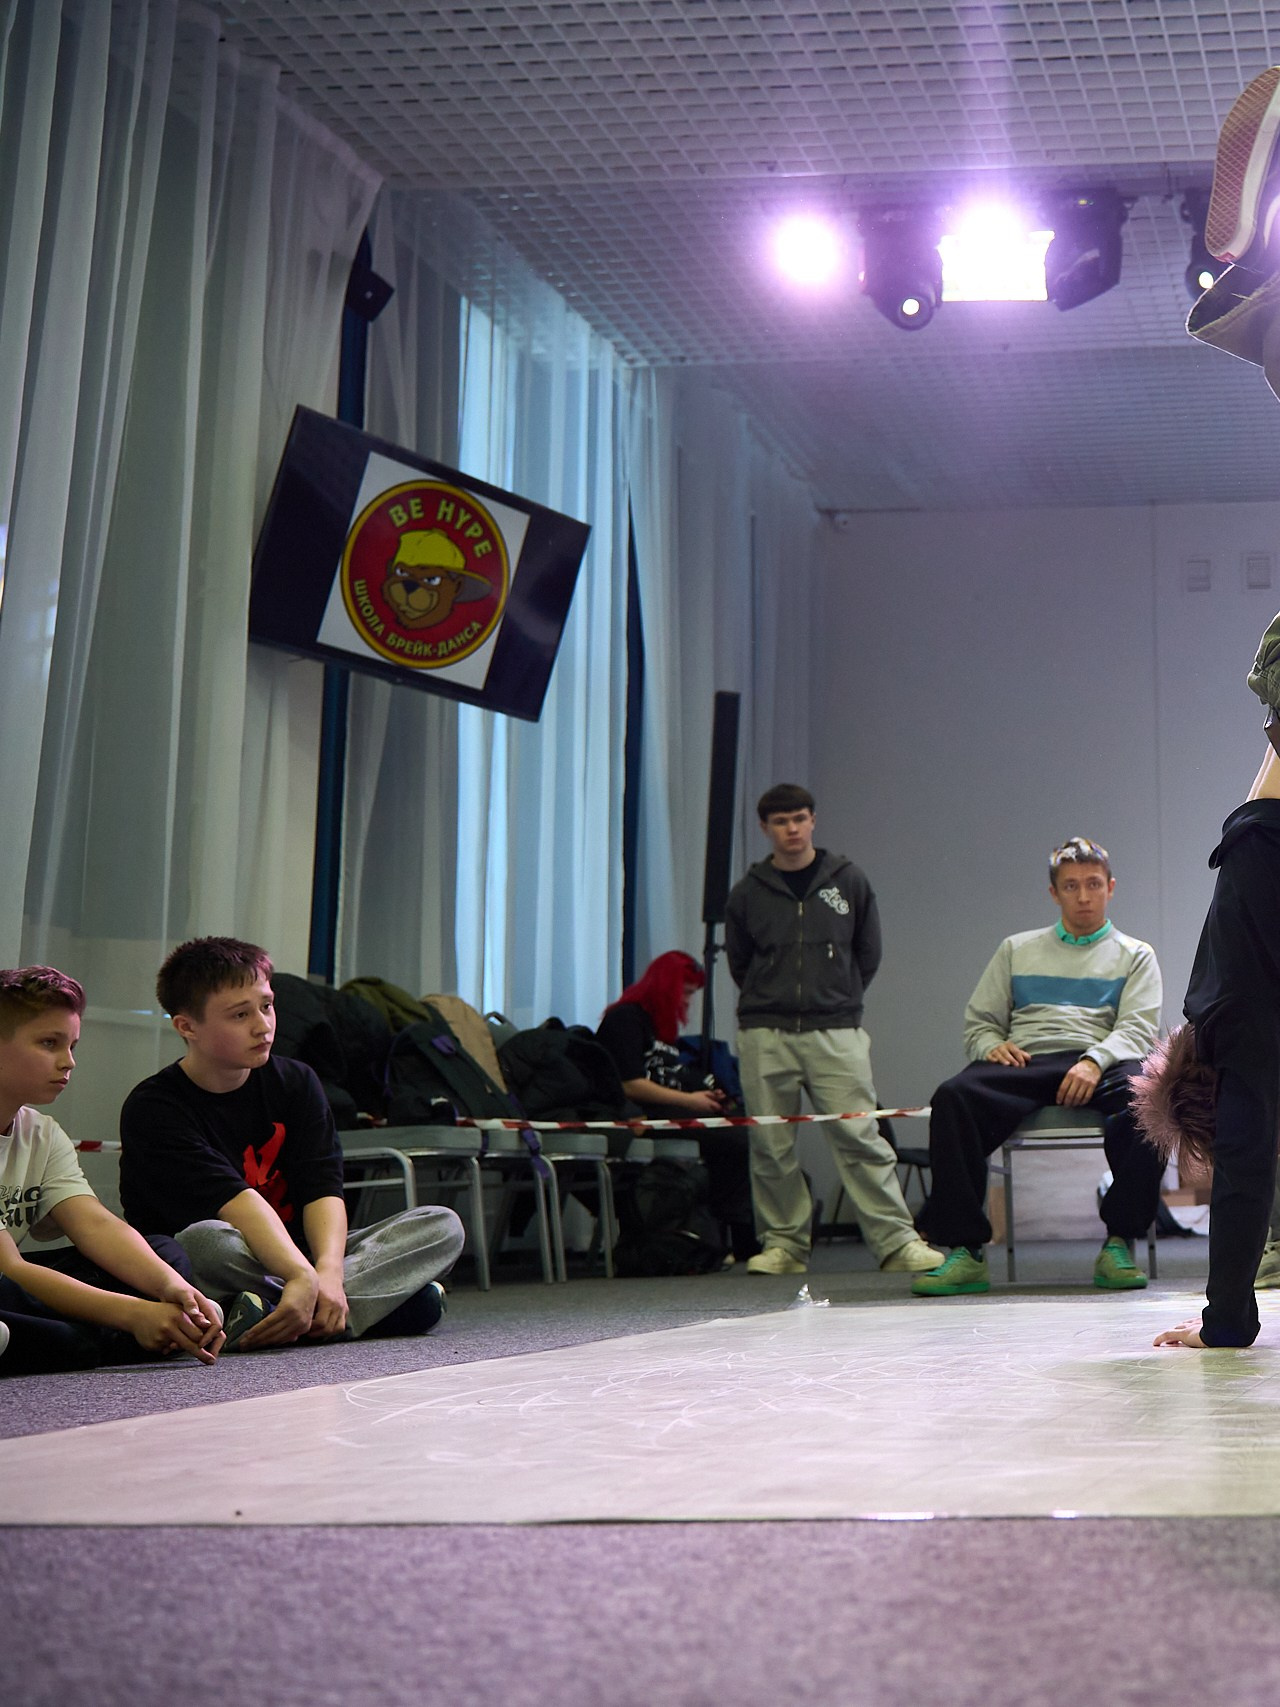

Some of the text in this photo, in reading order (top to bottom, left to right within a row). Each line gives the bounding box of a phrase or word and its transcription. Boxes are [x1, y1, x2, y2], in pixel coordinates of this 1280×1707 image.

[389, 499, 492, 558] BE HYPE
[354, 580, 482, 656] ШКОЛА БРЕЙК-ДАНСА
